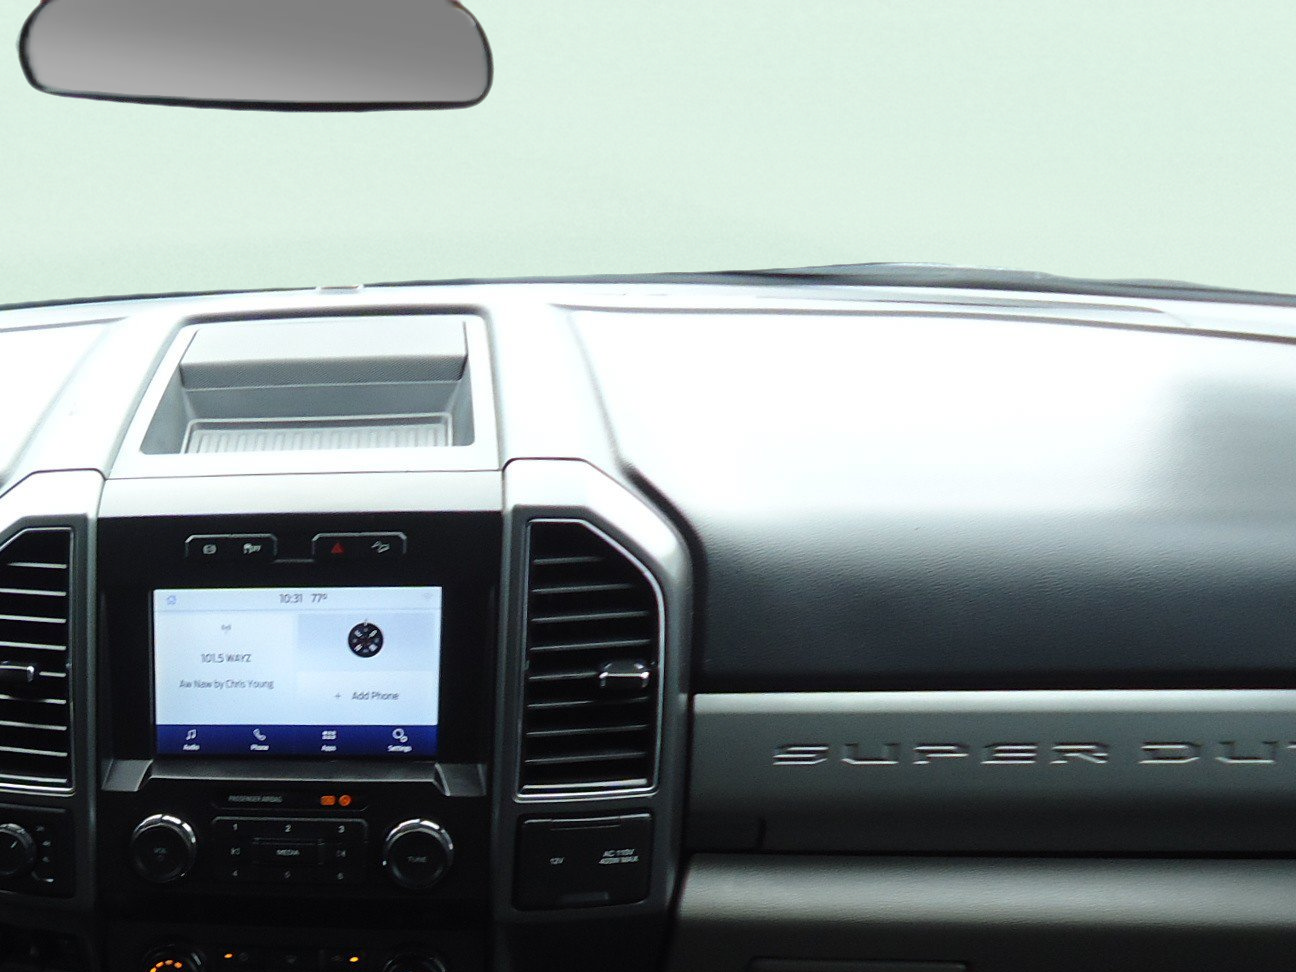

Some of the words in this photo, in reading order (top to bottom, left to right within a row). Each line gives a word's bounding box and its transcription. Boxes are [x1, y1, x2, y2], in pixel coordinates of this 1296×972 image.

[279, 593, 303, 604] 10:31
[200, 653, 225, 663] 101.5
[214, 680, 224, 690] by
[225, 679, 246, 689] Chris
[248, 679, 275, 690] Young
[352, 691, 370, 701] Add
[370, 691, 399, 701] Phone
[772, 741, 1111, 766] SUPER
[1137, 740, 1296, 766] DU
[284, 823, 292, 833] 2
[337, 825, 345, 834] 3
[276, 849, 301, 857] MEDIA
